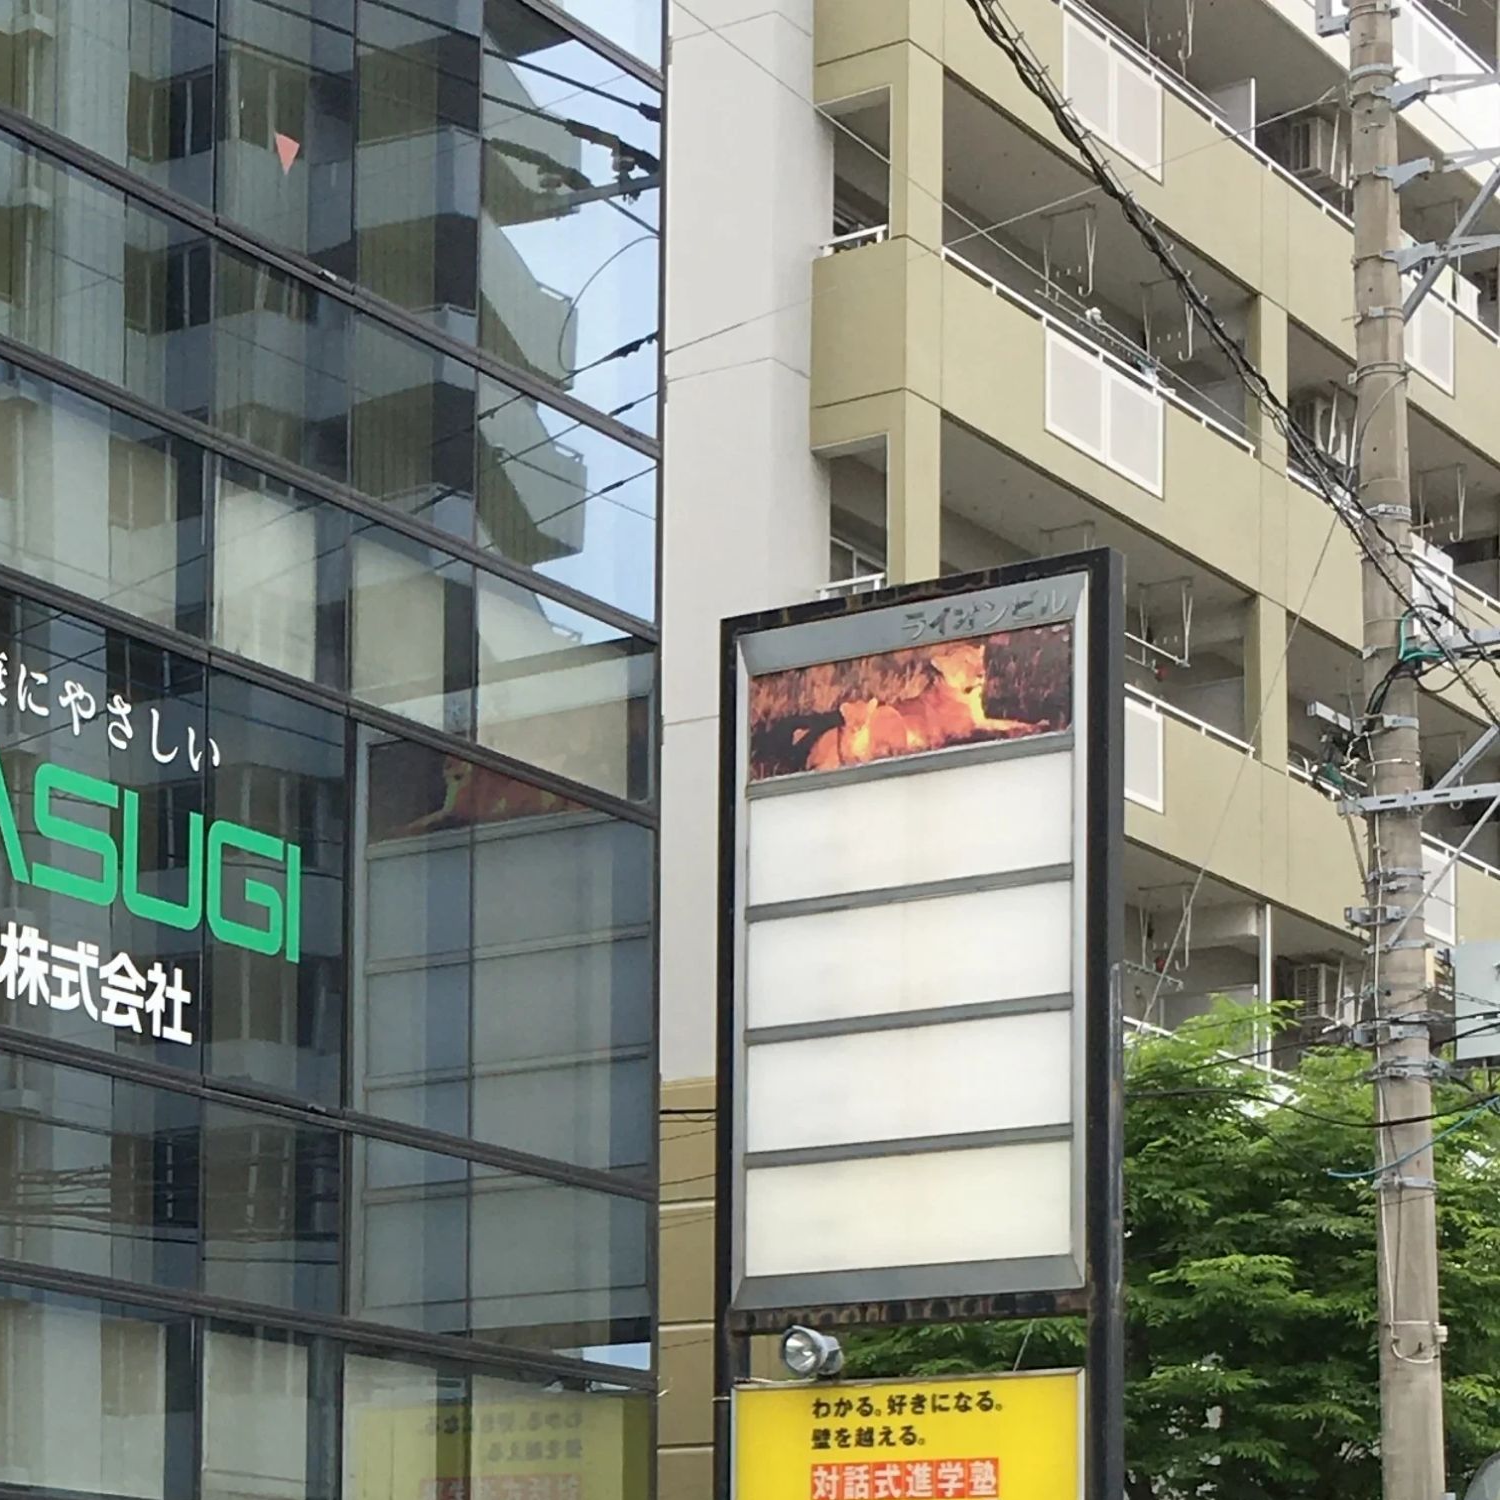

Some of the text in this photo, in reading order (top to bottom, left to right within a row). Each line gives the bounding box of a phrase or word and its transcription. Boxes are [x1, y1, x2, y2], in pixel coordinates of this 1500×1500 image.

[902, 588, 1068, 640] ライオンビル
[812, 1390, 1003, 1418] わかる。好きになる。
[811, 1426, 926, 1450] 壁を越える。
[812, 1459, 998, 1500] 対話式進学塾
